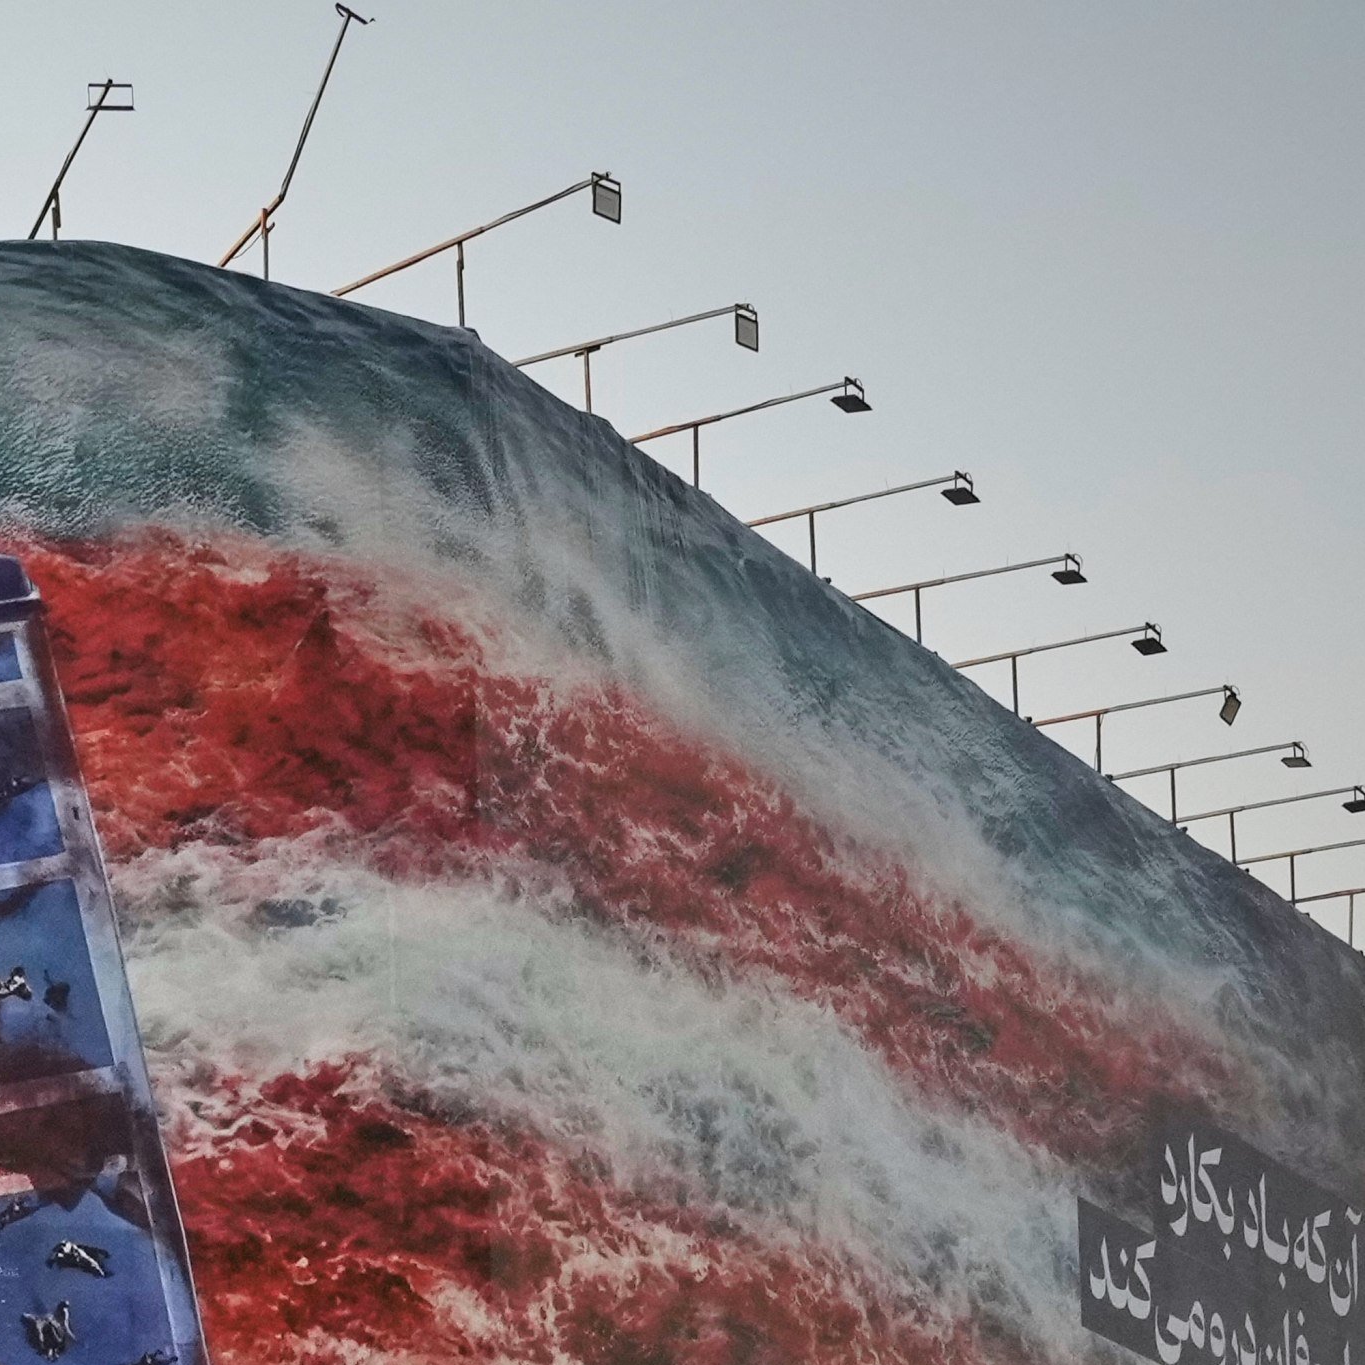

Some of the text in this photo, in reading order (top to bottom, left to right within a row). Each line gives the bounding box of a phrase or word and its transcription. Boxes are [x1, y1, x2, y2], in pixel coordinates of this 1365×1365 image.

[1160, 1132, 1363, 1317] آن که باد بکارد
